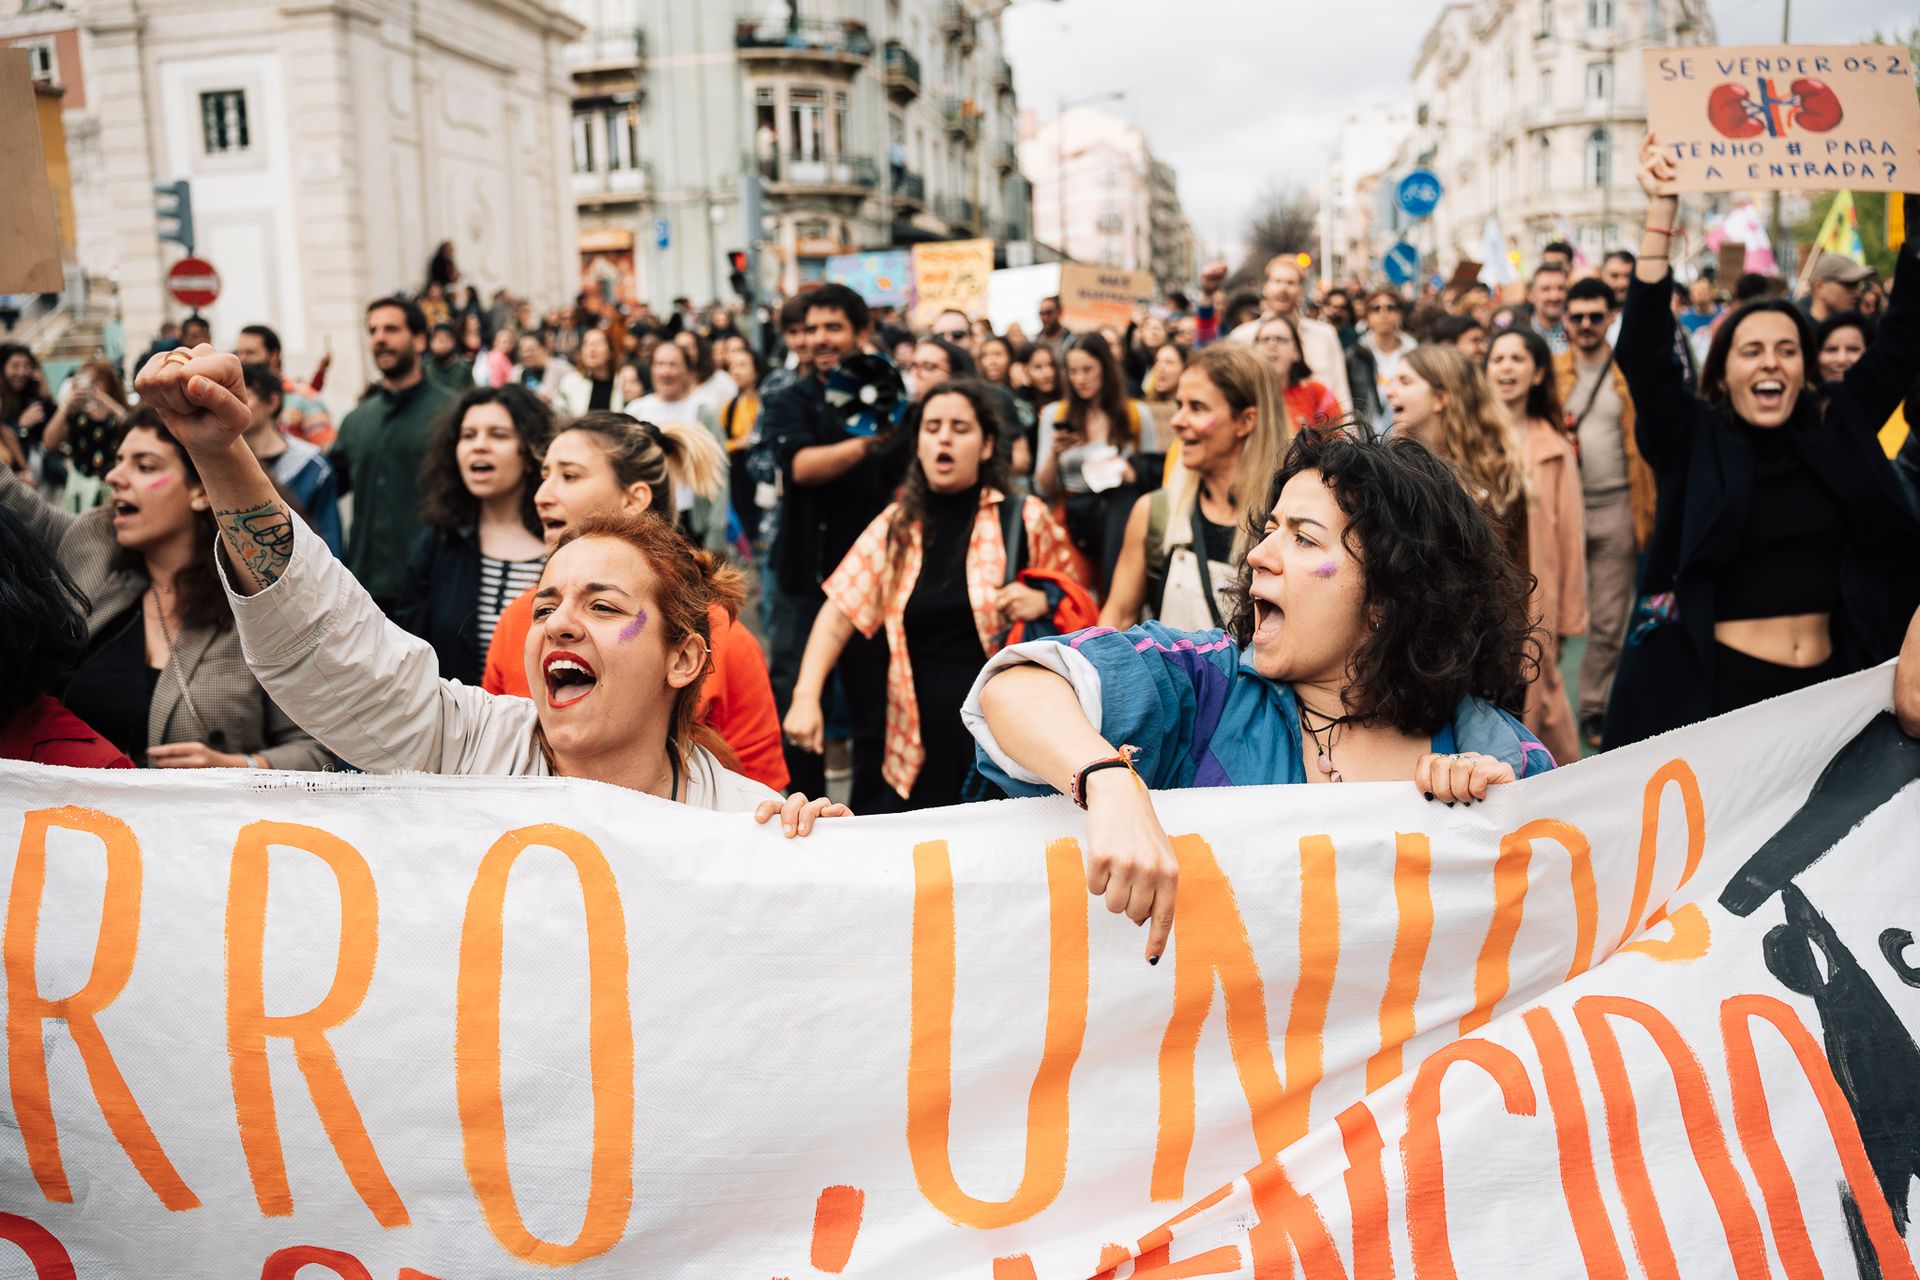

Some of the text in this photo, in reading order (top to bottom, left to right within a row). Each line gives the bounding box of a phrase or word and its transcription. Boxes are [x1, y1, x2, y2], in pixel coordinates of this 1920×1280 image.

[1659, 58, 1694, 81] SE
[1717, 56, 1831, 76] VENDER
[1844, 56, 1877, 72] OS
[1671, 141, 1763, 159] TENHO
[1826, 140, 1896, 156] PARA
[1706, 162, 1897, 182] A ENTRADA?
